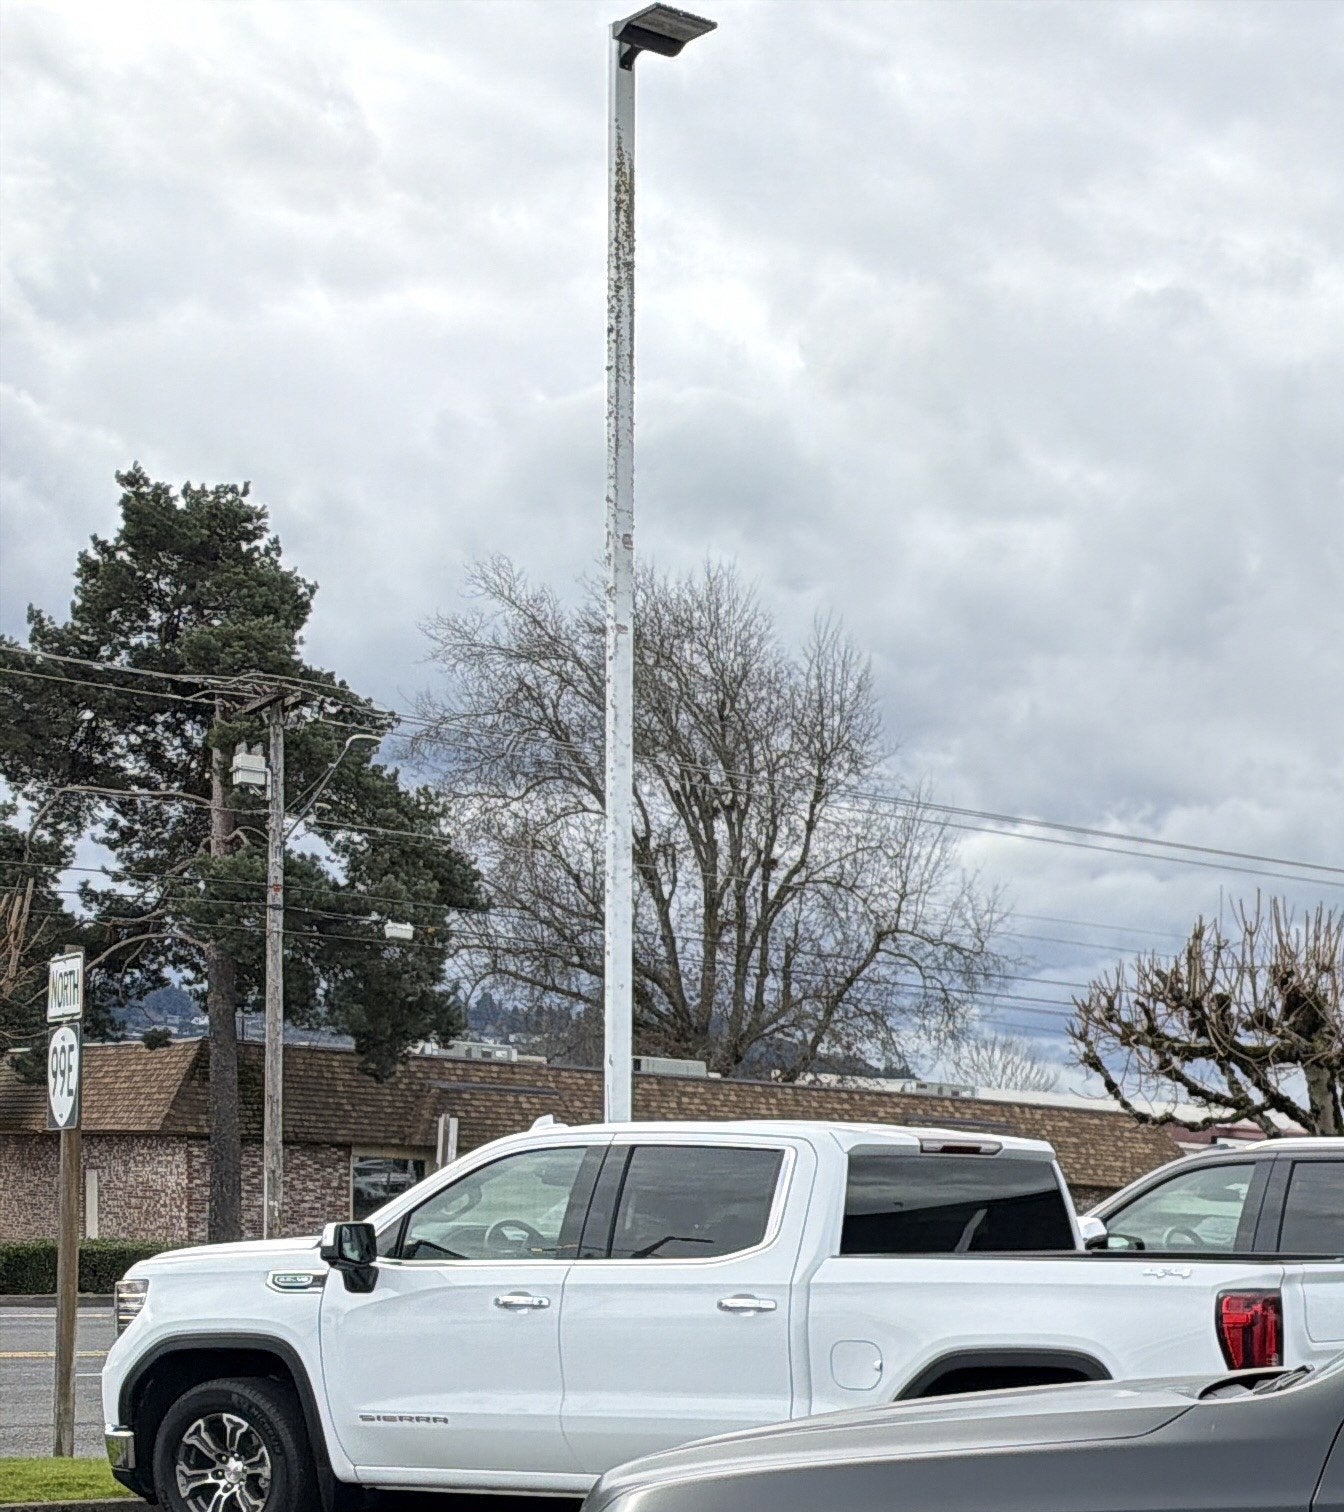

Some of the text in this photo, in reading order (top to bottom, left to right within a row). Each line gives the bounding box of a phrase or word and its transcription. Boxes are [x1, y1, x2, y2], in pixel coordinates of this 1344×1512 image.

[51, 969, 79, 1008] NORTH
[51, 1044, 75, 1098] 99E
[359, 1415, 448, 1424] SIERRA
